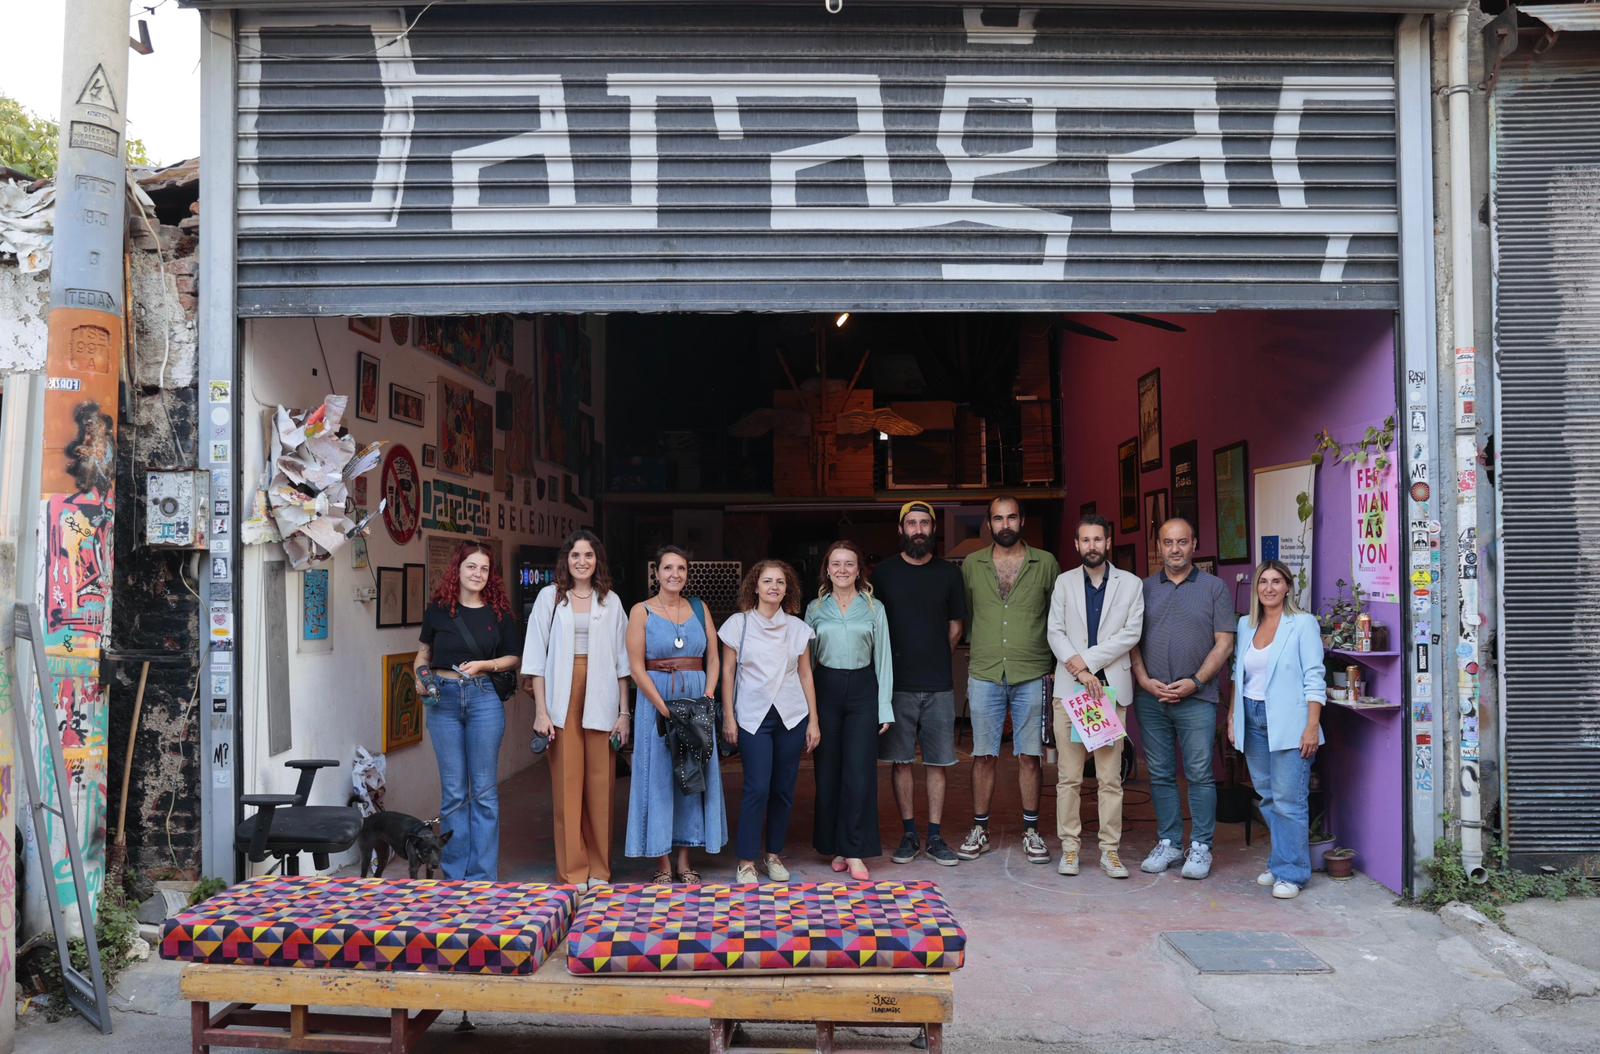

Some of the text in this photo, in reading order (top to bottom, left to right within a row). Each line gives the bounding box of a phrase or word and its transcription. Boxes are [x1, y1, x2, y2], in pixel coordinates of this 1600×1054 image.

[1358, 491, 1389, 514] MAN
[1358, 543, 1388, 565] YON
[1074, 699, 1103, 718] MAN
[1078, 710, 1101, 727] TAS
[1083, 718, 1111, 736] YON
